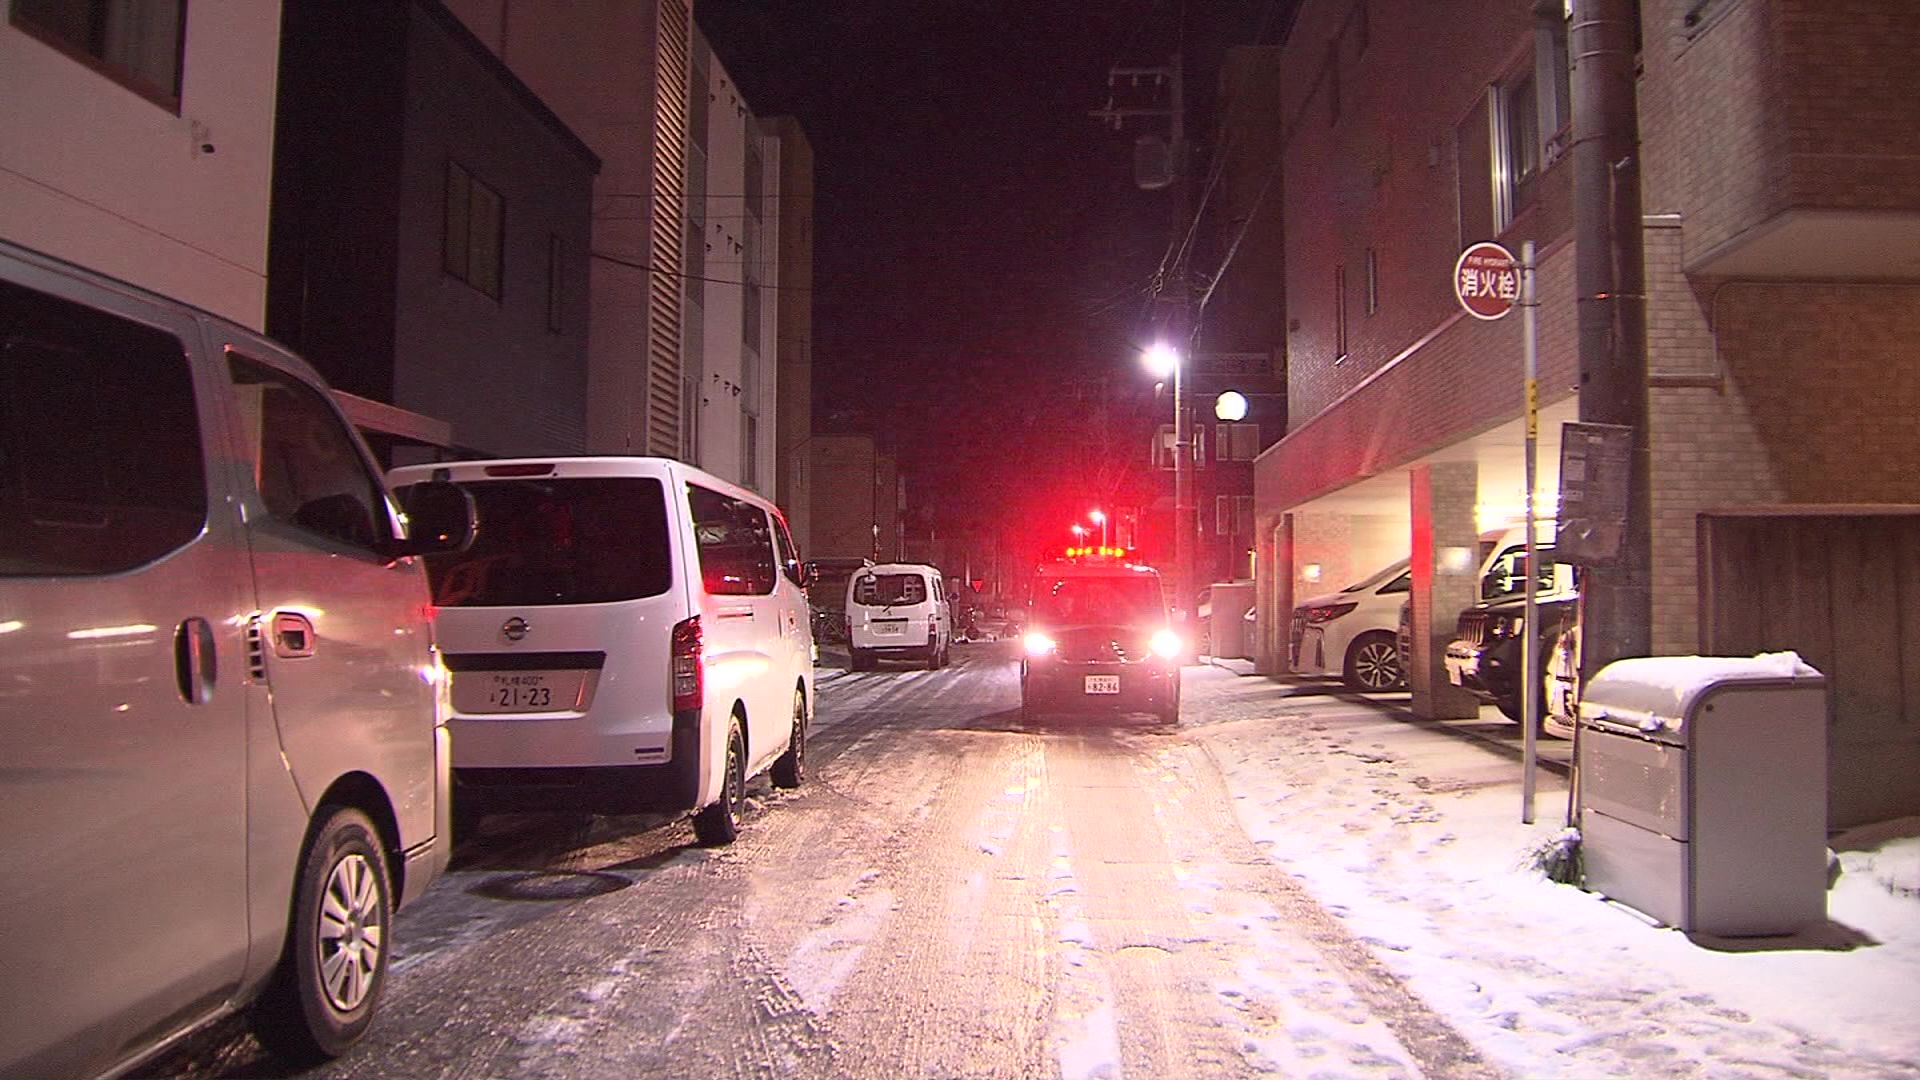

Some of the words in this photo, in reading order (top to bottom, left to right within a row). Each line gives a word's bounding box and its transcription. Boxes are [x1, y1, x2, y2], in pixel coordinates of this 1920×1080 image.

[1461, 268, 1515, 299] 消火栓
[499, 688, 550, 706] 21-23
